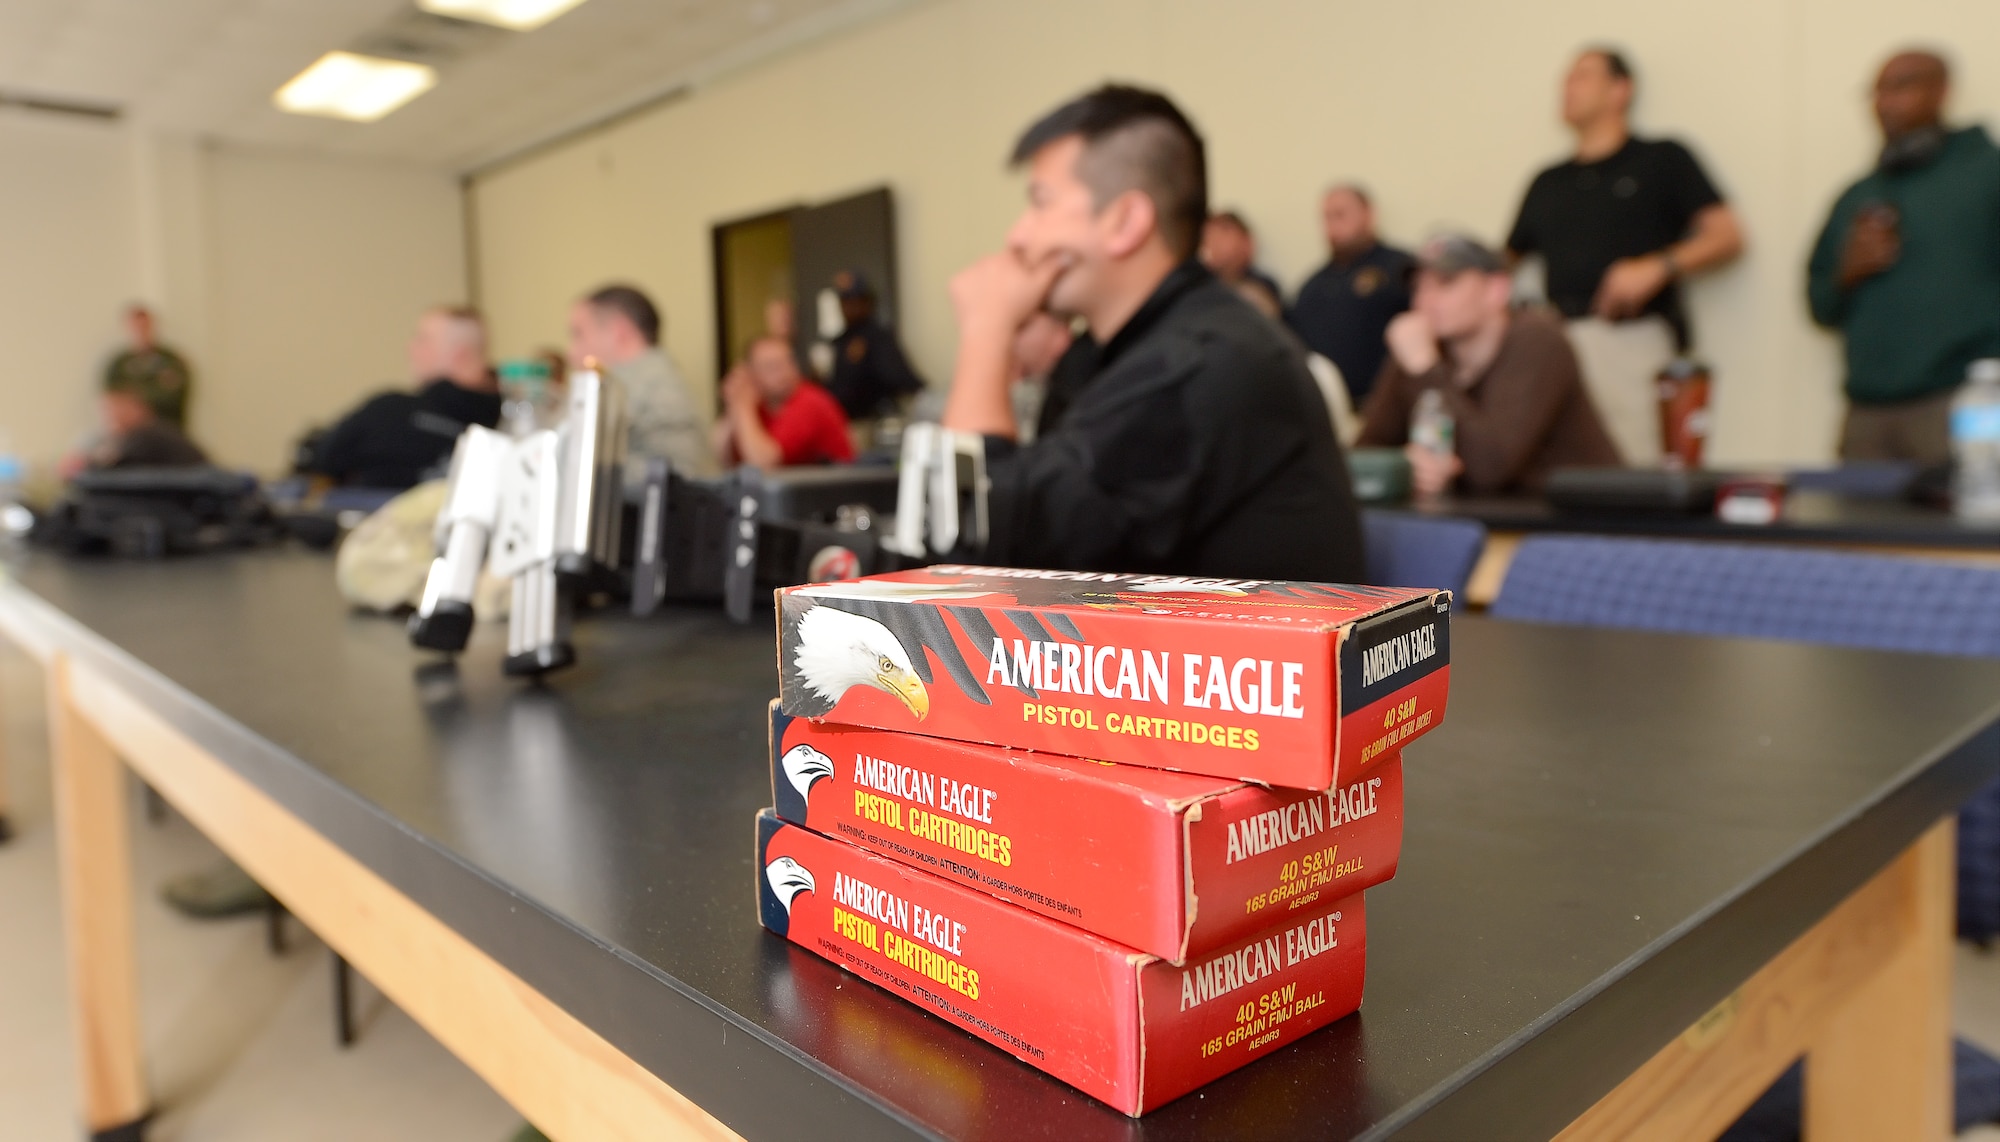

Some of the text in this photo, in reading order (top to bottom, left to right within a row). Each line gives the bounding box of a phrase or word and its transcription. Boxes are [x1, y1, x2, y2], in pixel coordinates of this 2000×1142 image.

[1125, 575, 1273, 589] EAGLE
[986, 637, 1304, 719] AMERICAN EAGLE
[1362, 622, 1436, 688] AMERICAN EAGLE
[1023, 702, 1260, 751] PISTOL CARTRIDGES
[1360, 709, 1433, 765] 165 GRAIN FULL METAL JACKET
[1383, 695, 1418, 730] 40 S&W
[854, 753, 935, 808] AMERICAN
[854, 789, 1012, 868] PISTOL CARTRIDGES
[1226, 795, 1324, 865] AMERICAN
[837, 822, 867, 840] WARNING:
[940, 858, 981, 882] ATTENTION:
[986, 876, 1008, 891] GARDER
[1008, 885, 1023, 897] HORS
[1045, 897, 1056, 909] DES
[1057, 901, 1083, 918] ENFANTS
[1245, 856, 1364, 914] 165 GRAIN FMJ BALL
[1280, 844, 1338, 883] 40 S&W
[832, 871, 909, 934] AMERICAN
[1289, 890, 1319, 911] AE40R3
[833, 906, 980, 1001] PISTOL CARTRIDGES
[1180, 934, 1281, 1012] AMERICAN
[912, 985, 951, 1013] ATTENTION:
[1021, 1041, 1045, 1060] ENFANTS
[1201, 990, 1326, 1059] 165 GRAIN FMJ BALL
[1235, 981, 1296, 1025] 40 S&W
[1249, 1028, 1280, 1052] AE40R3
